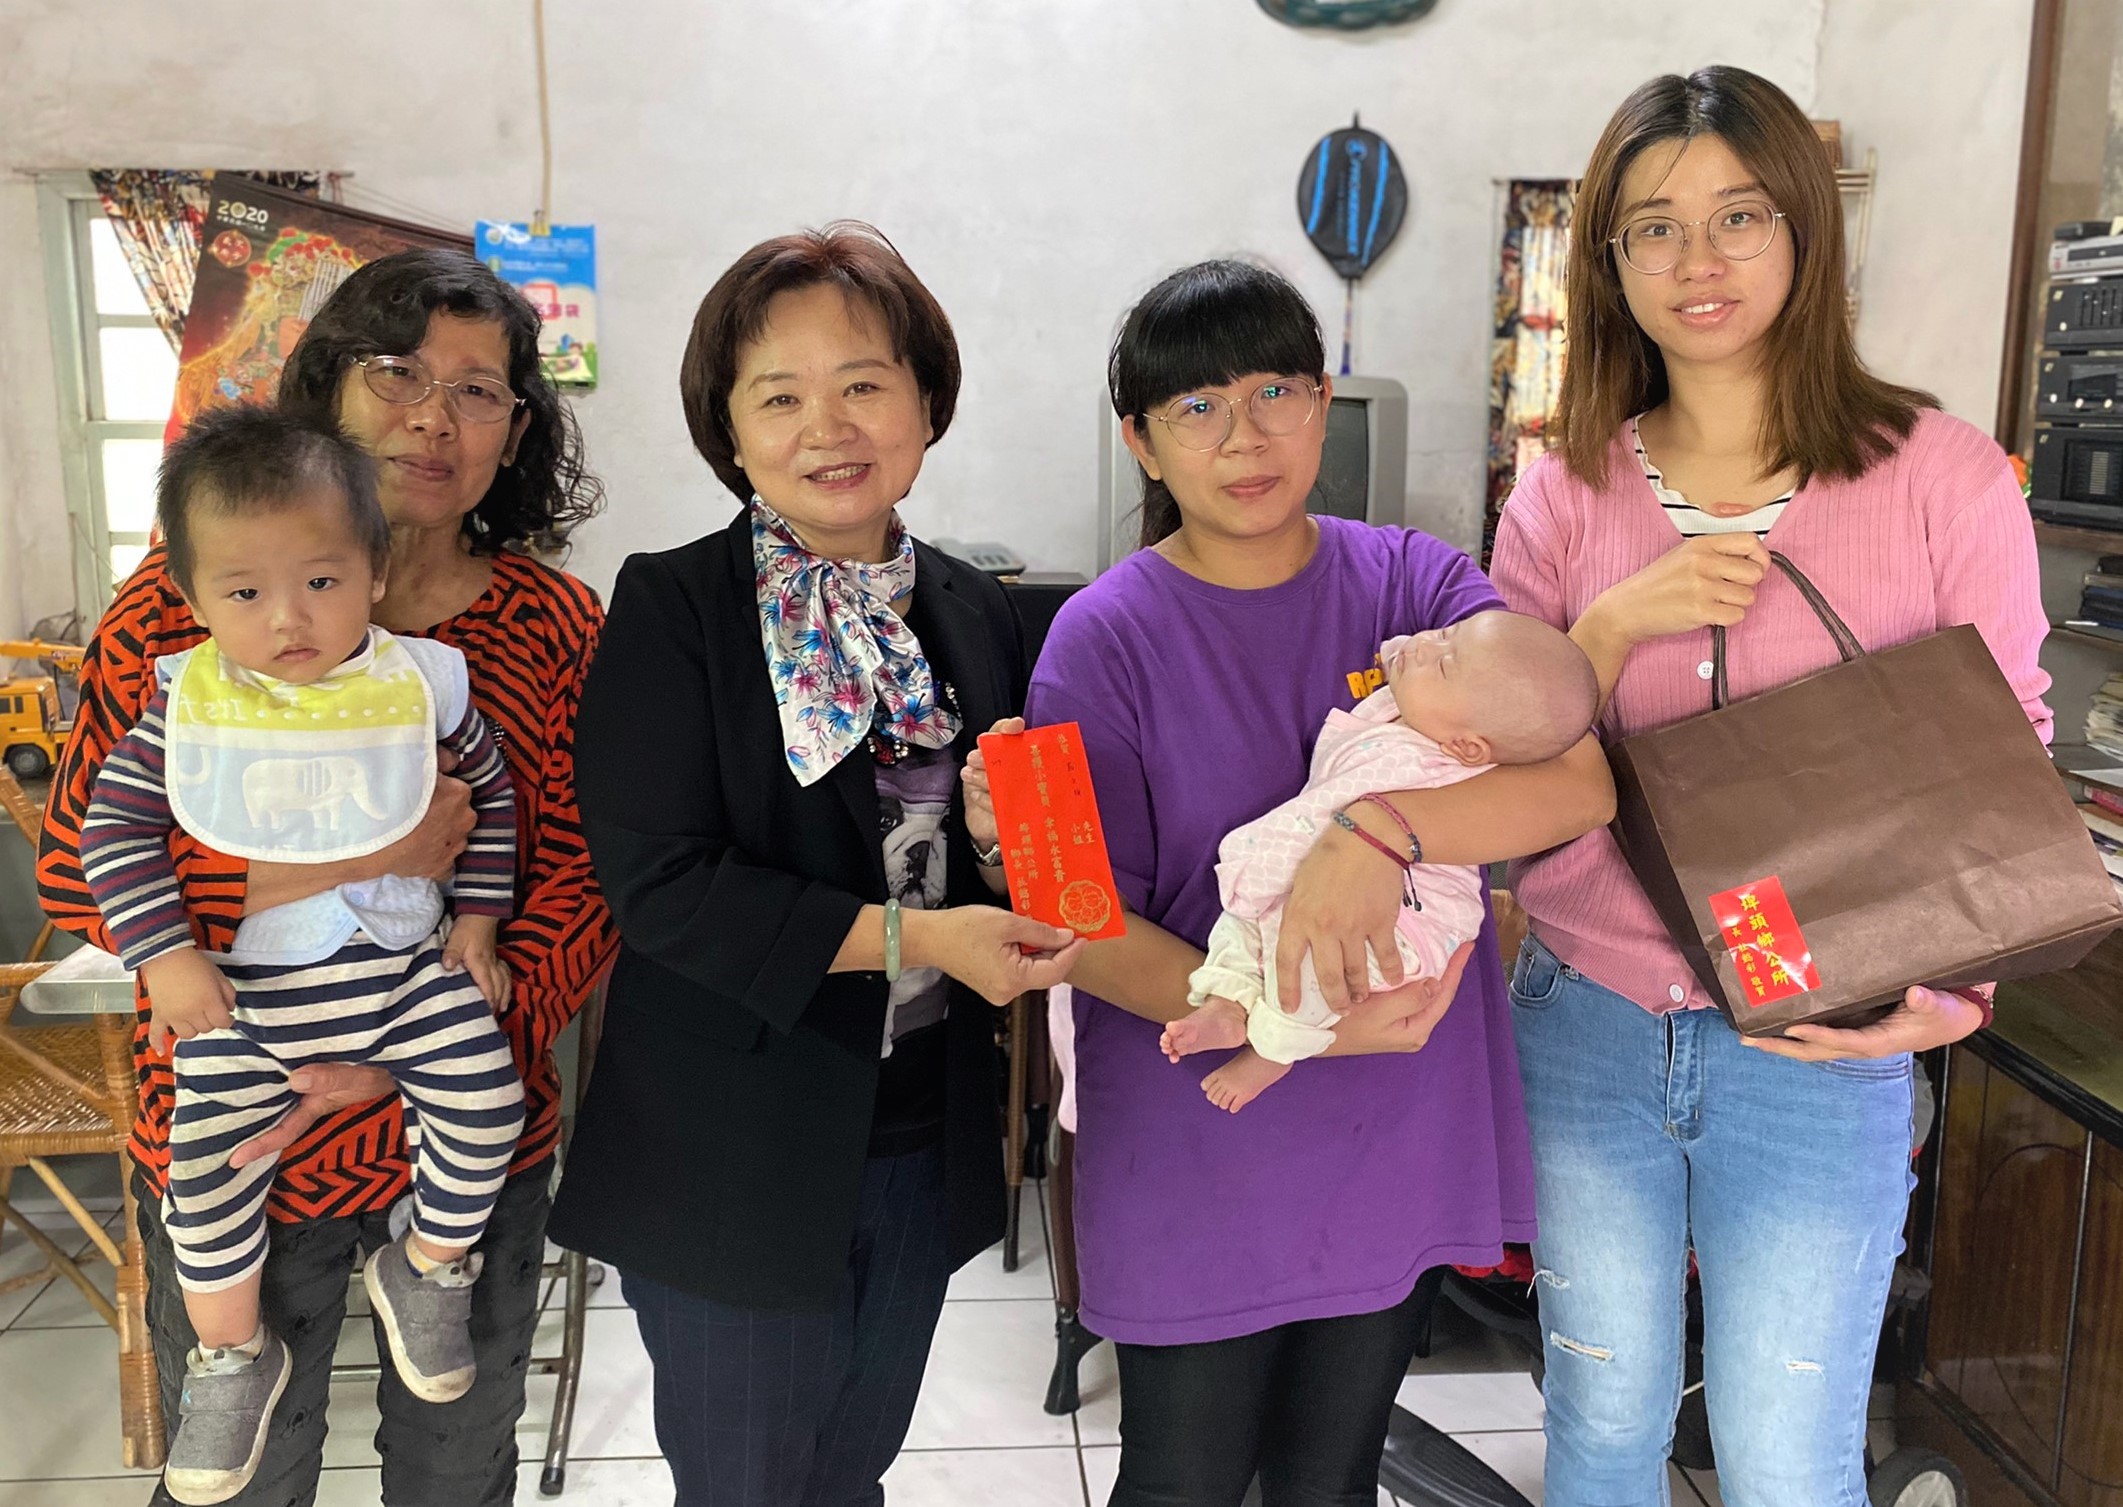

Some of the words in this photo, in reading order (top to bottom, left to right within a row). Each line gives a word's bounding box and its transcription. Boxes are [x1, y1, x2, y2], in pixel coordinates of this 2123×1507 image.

[218, 200, 269, 224] 2020
[1741, 894, 1790, 986] 埤頭鄉公所
